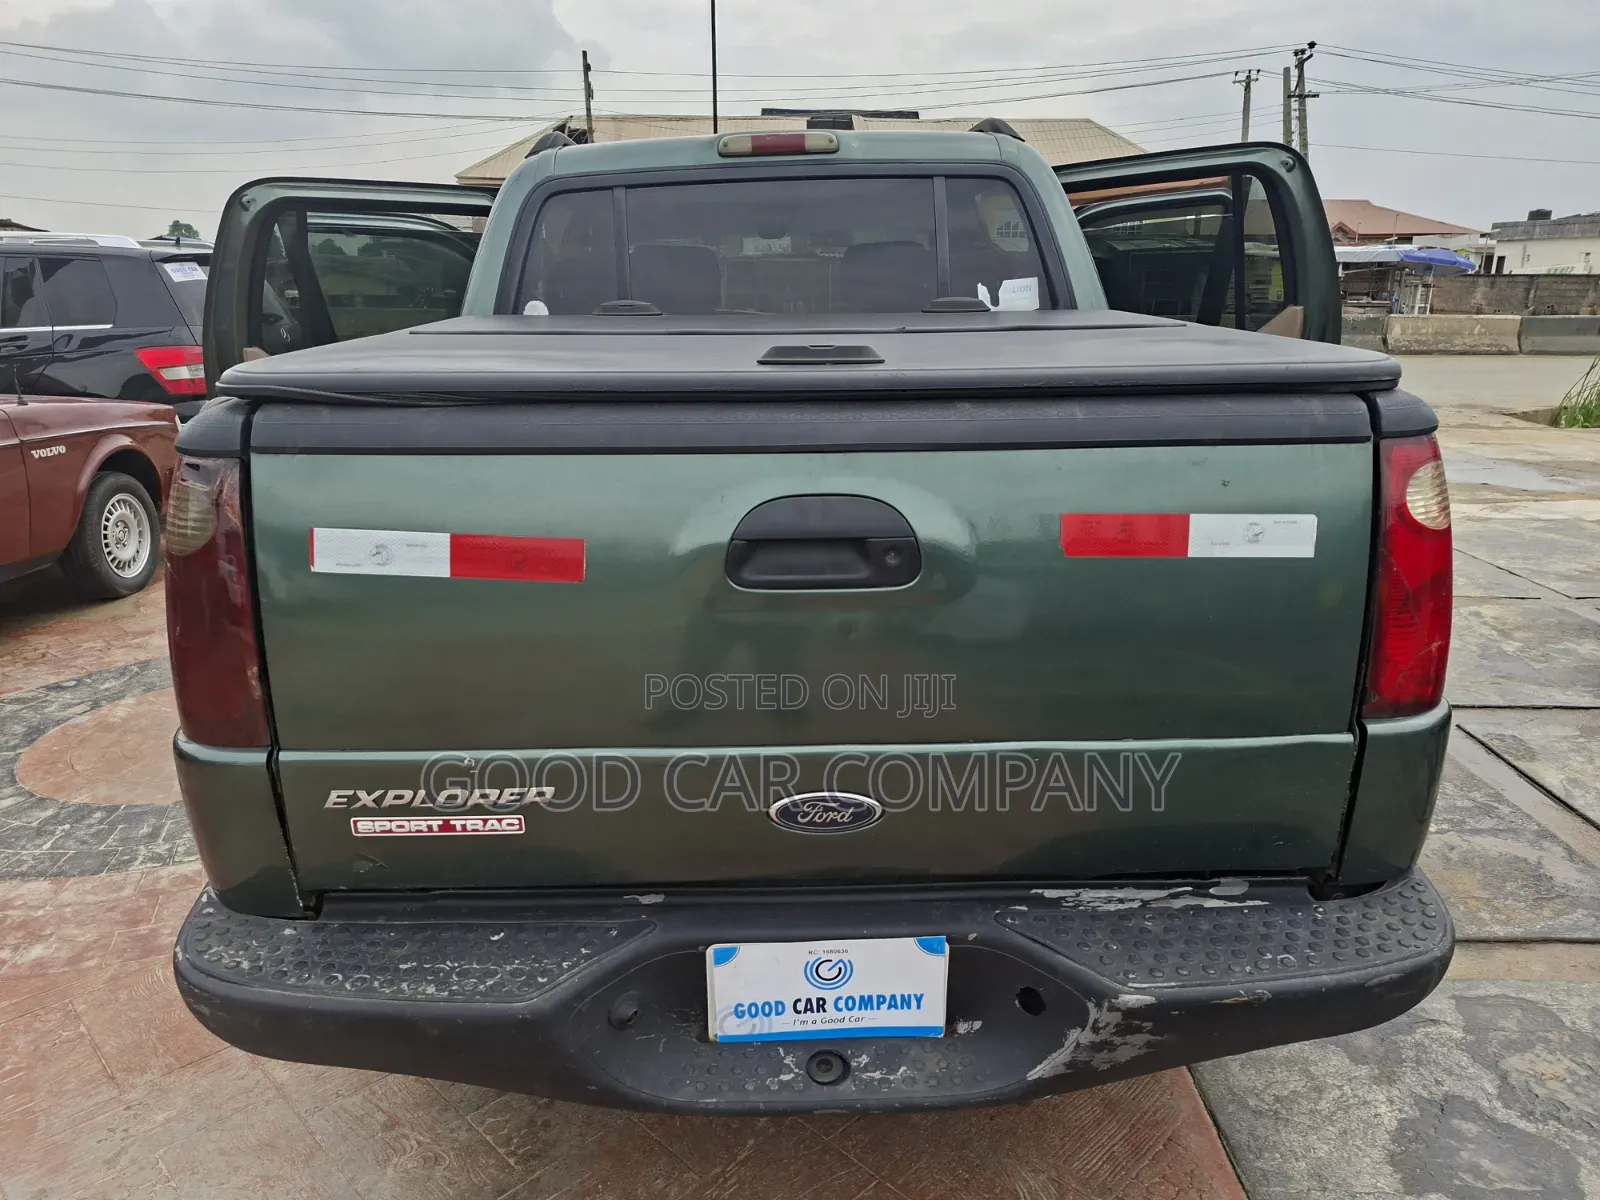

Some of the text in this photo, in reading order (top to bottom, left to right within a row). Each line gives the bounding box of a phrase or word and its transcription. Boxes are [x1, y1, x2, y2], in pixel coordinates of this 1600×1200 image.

[31, 445, 66, 459] VOLVO
[324, 786, 556, 811] EXPLORER
[797, 801, 855, 823] Ford
[357, 817, 521, 834] SPORT TRAC
[733, 993, 925, 1020] GOOD CAR COMPANY
[793, 1018, 808, 1026] I'm
[820, 1016, 845, 1024] Good
[848, 1015, 866, 1023] Car
